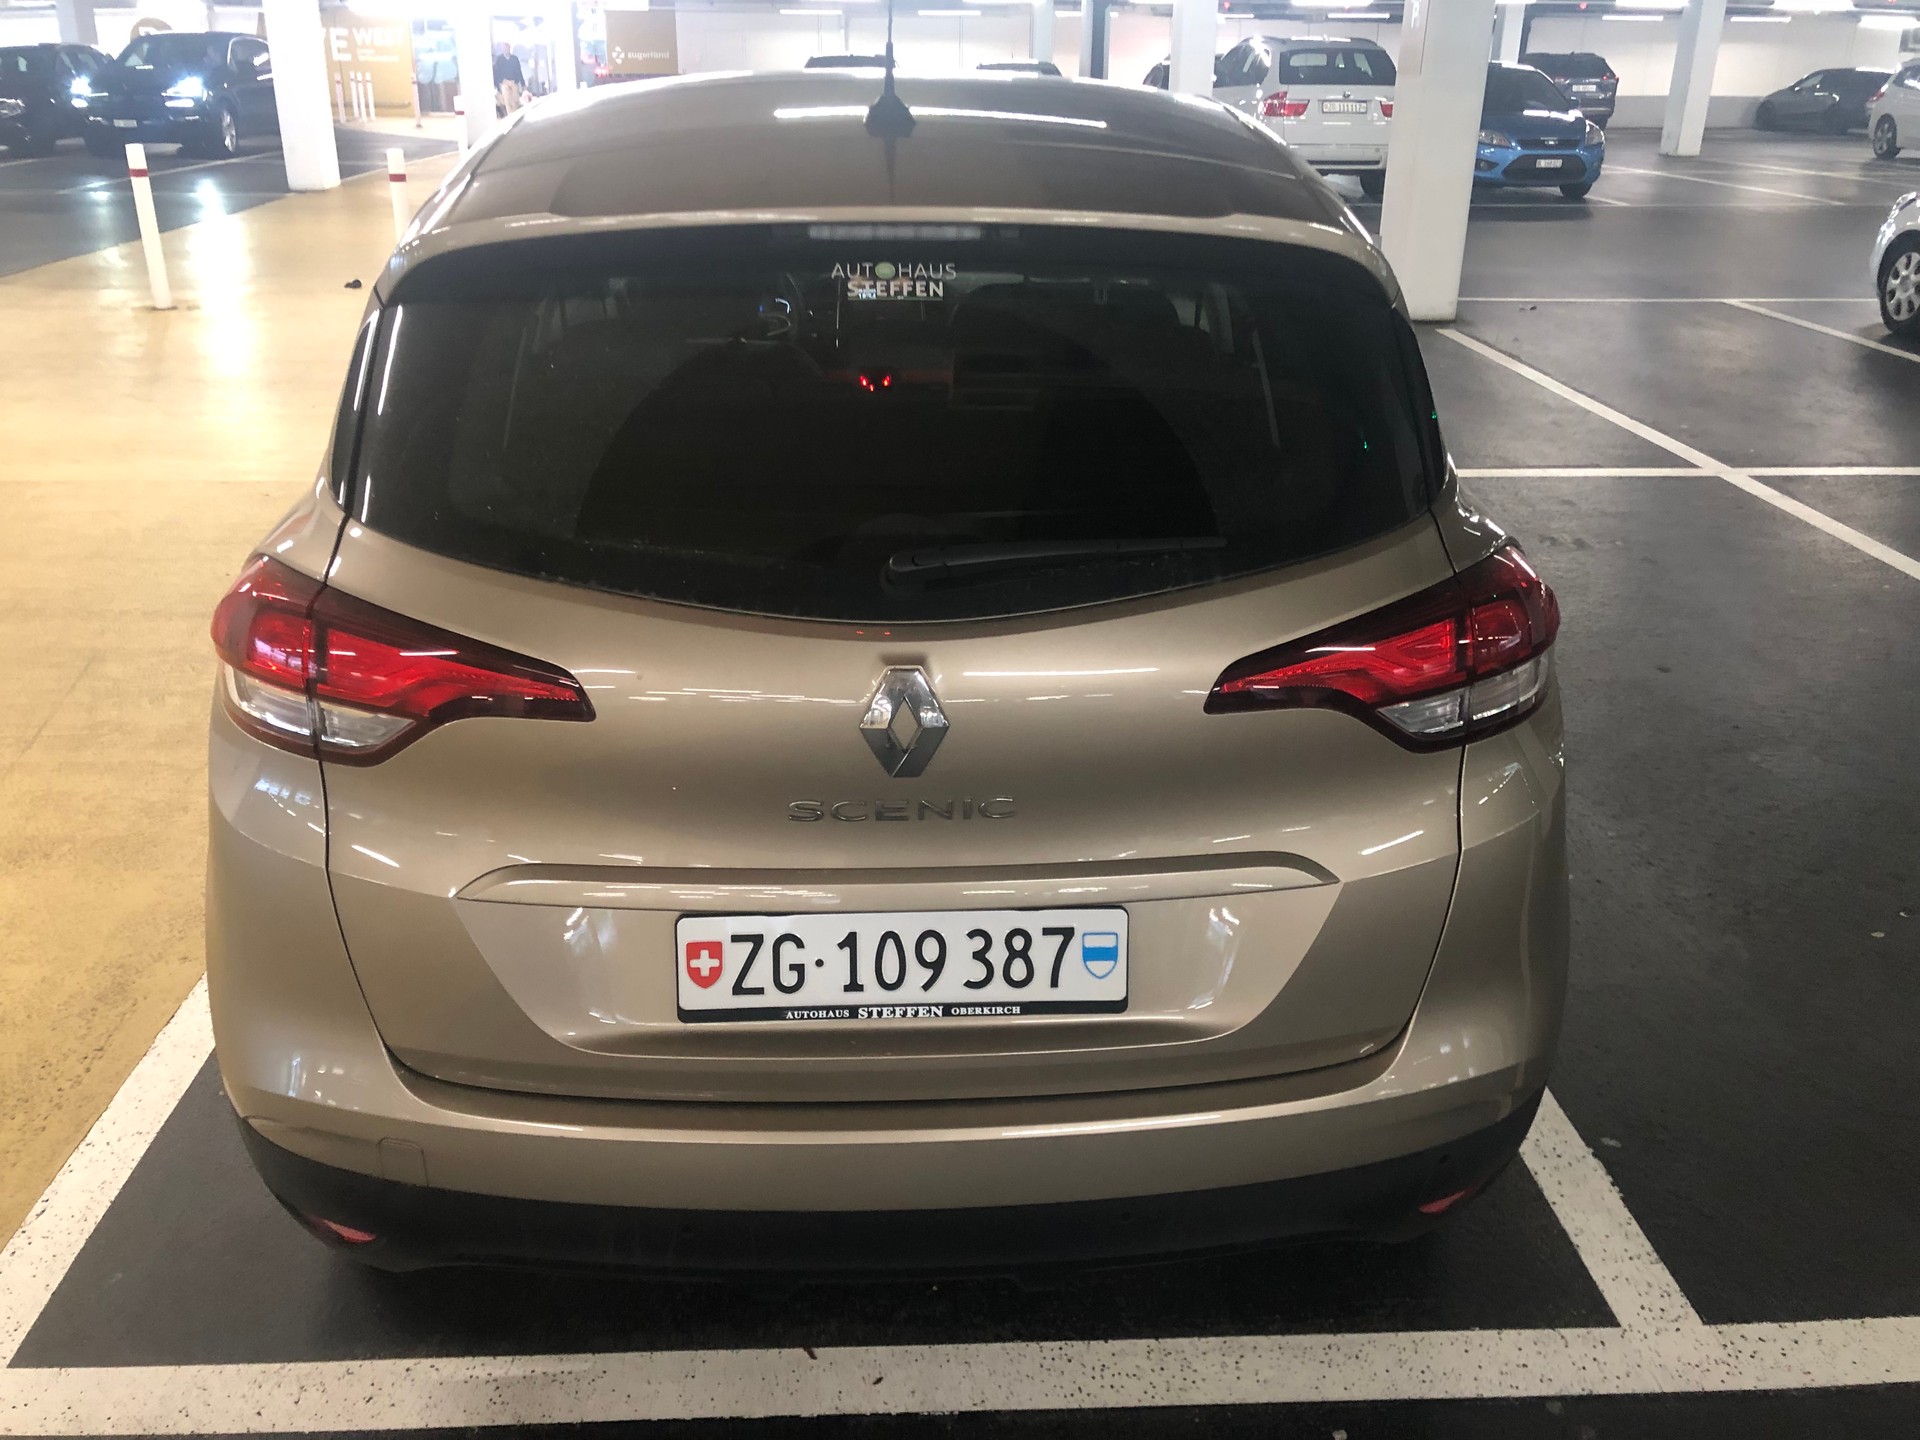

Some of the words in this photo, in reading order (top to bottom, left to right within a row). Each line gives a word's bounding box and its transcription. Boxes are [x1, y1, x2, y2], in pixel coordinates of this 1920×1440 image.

[847, 280, 944, 297] STEFFEN
[788, 796, 1015, 822] SCENIC
[785, 1008, 850, 1020] AUTOHAUS
[857, 1004, 944, 1019] STEFFEN
[951, 1005, 1021, 1016] OBERKIRCH
